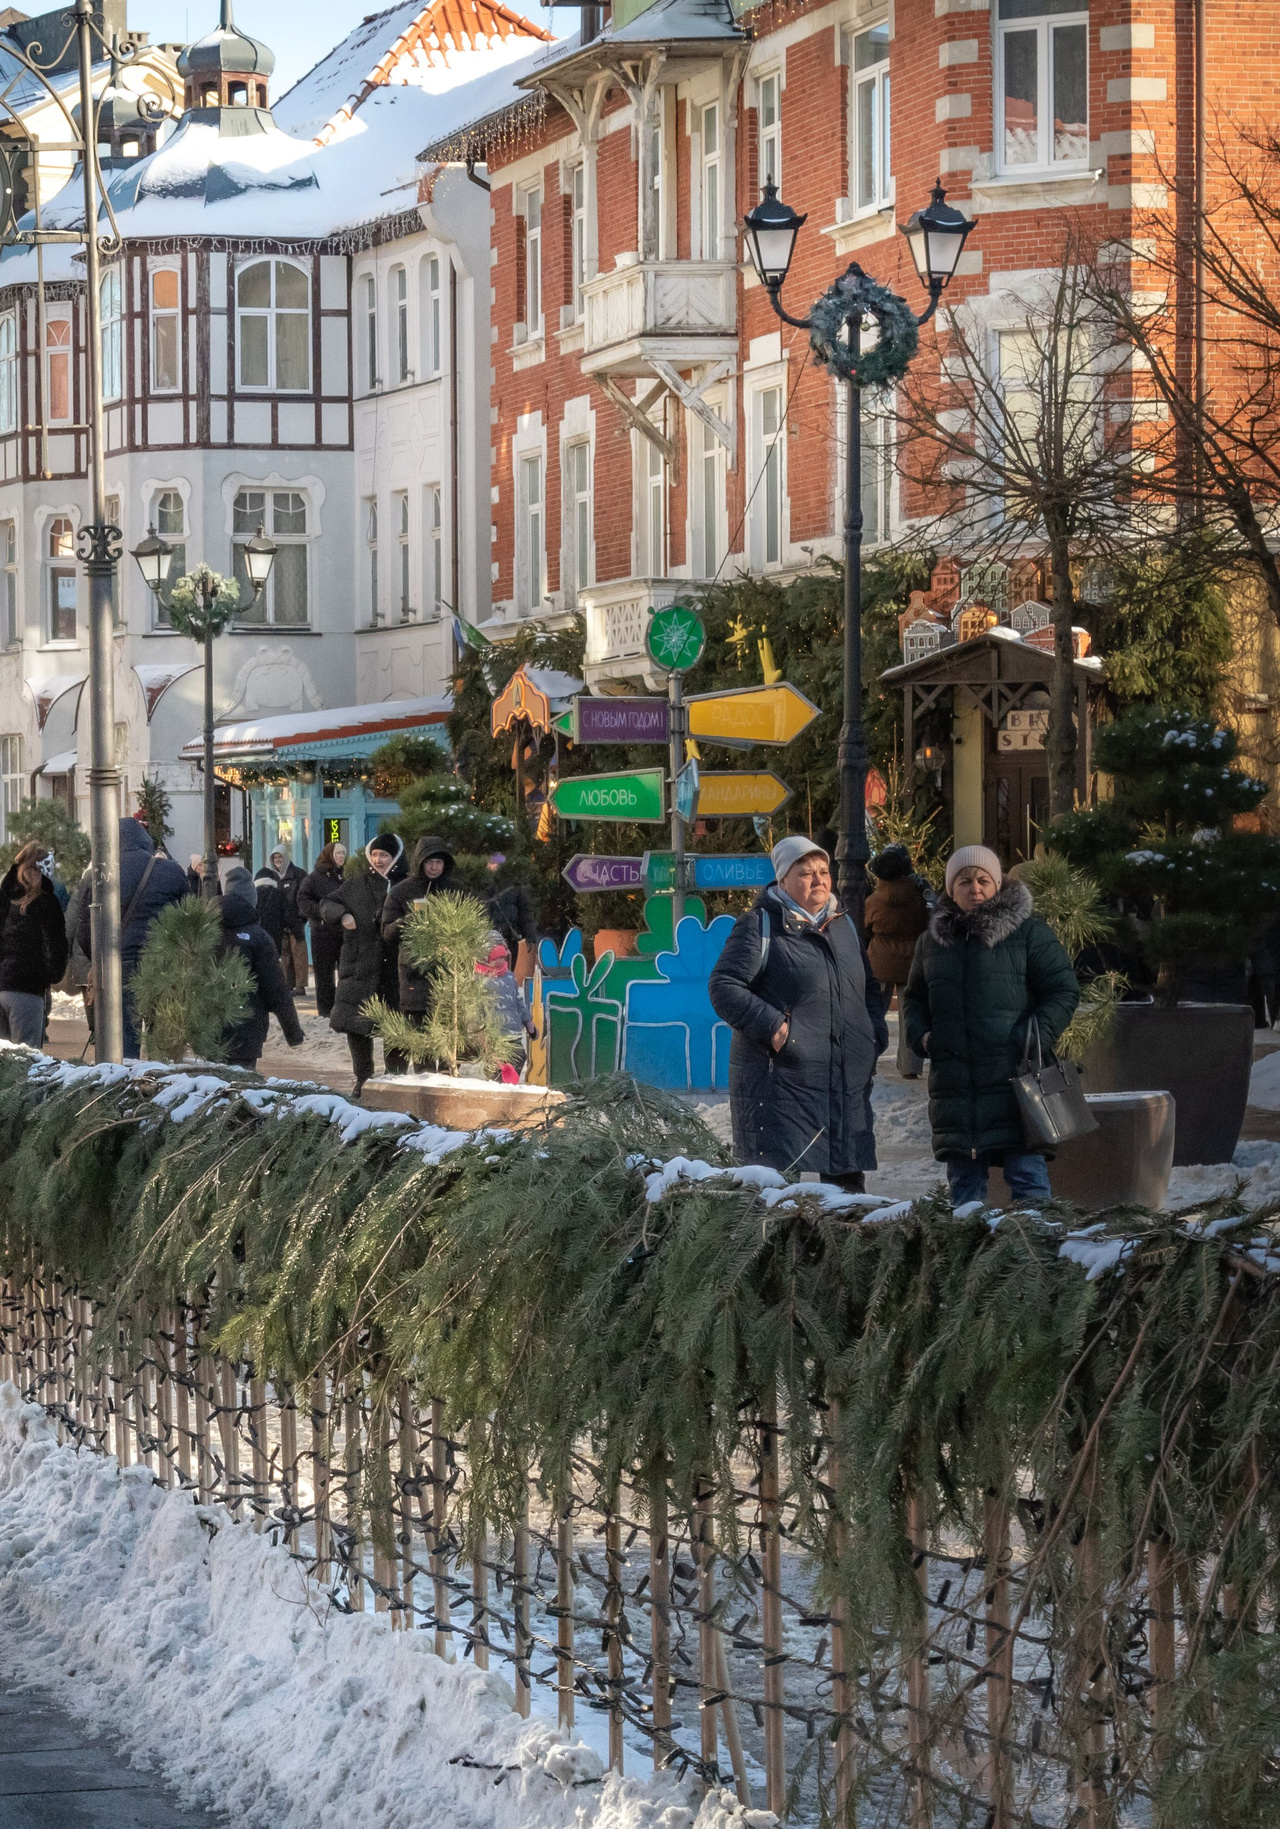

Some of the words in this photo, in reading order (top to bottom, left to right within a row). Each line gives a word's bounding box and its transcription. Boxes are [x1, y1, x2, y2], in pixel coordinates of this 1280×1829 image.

[582, 711, 589, 727] С
[591, 711, 627, 728] НОВЫМ
[579, 788, 637, 806] ЛЮБОВЬ
[577, 864, 642, 883] СЧАСТЬ
[702, 863, 765, 881] ОЛИВЬЕ
